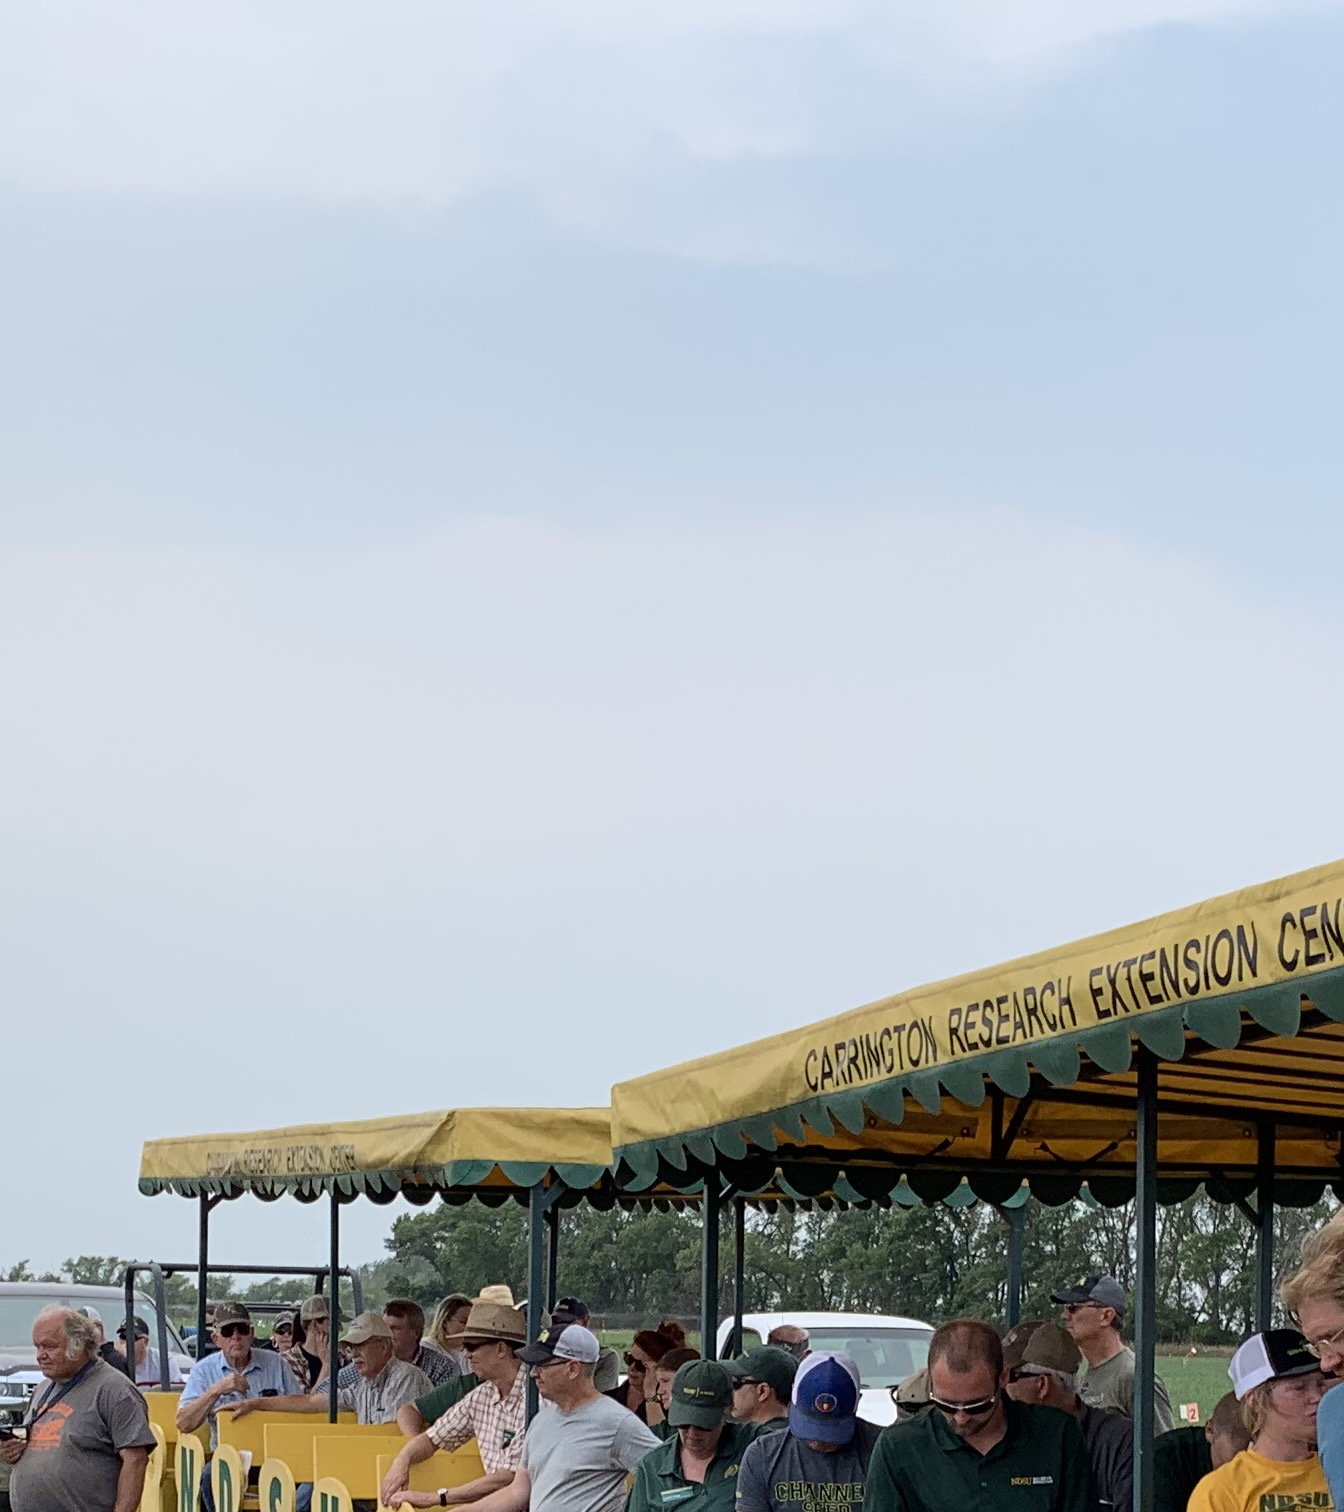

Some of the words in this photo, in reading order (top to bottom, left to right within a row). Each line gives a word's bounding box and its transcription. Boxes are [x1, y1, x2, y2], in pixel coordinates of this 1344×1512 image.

[805, 1016, 939, 1092] CARRINGTON
[948, 976, 1077, 1056] RESEARCH
[1089, 921, 1258, 1020] EXTENSION
[1189, 1408, 1197, 1420] 2
[775, 1481, 866, 1503] CHANNE
[1259, 1491, 1329, 1512] NDSU
